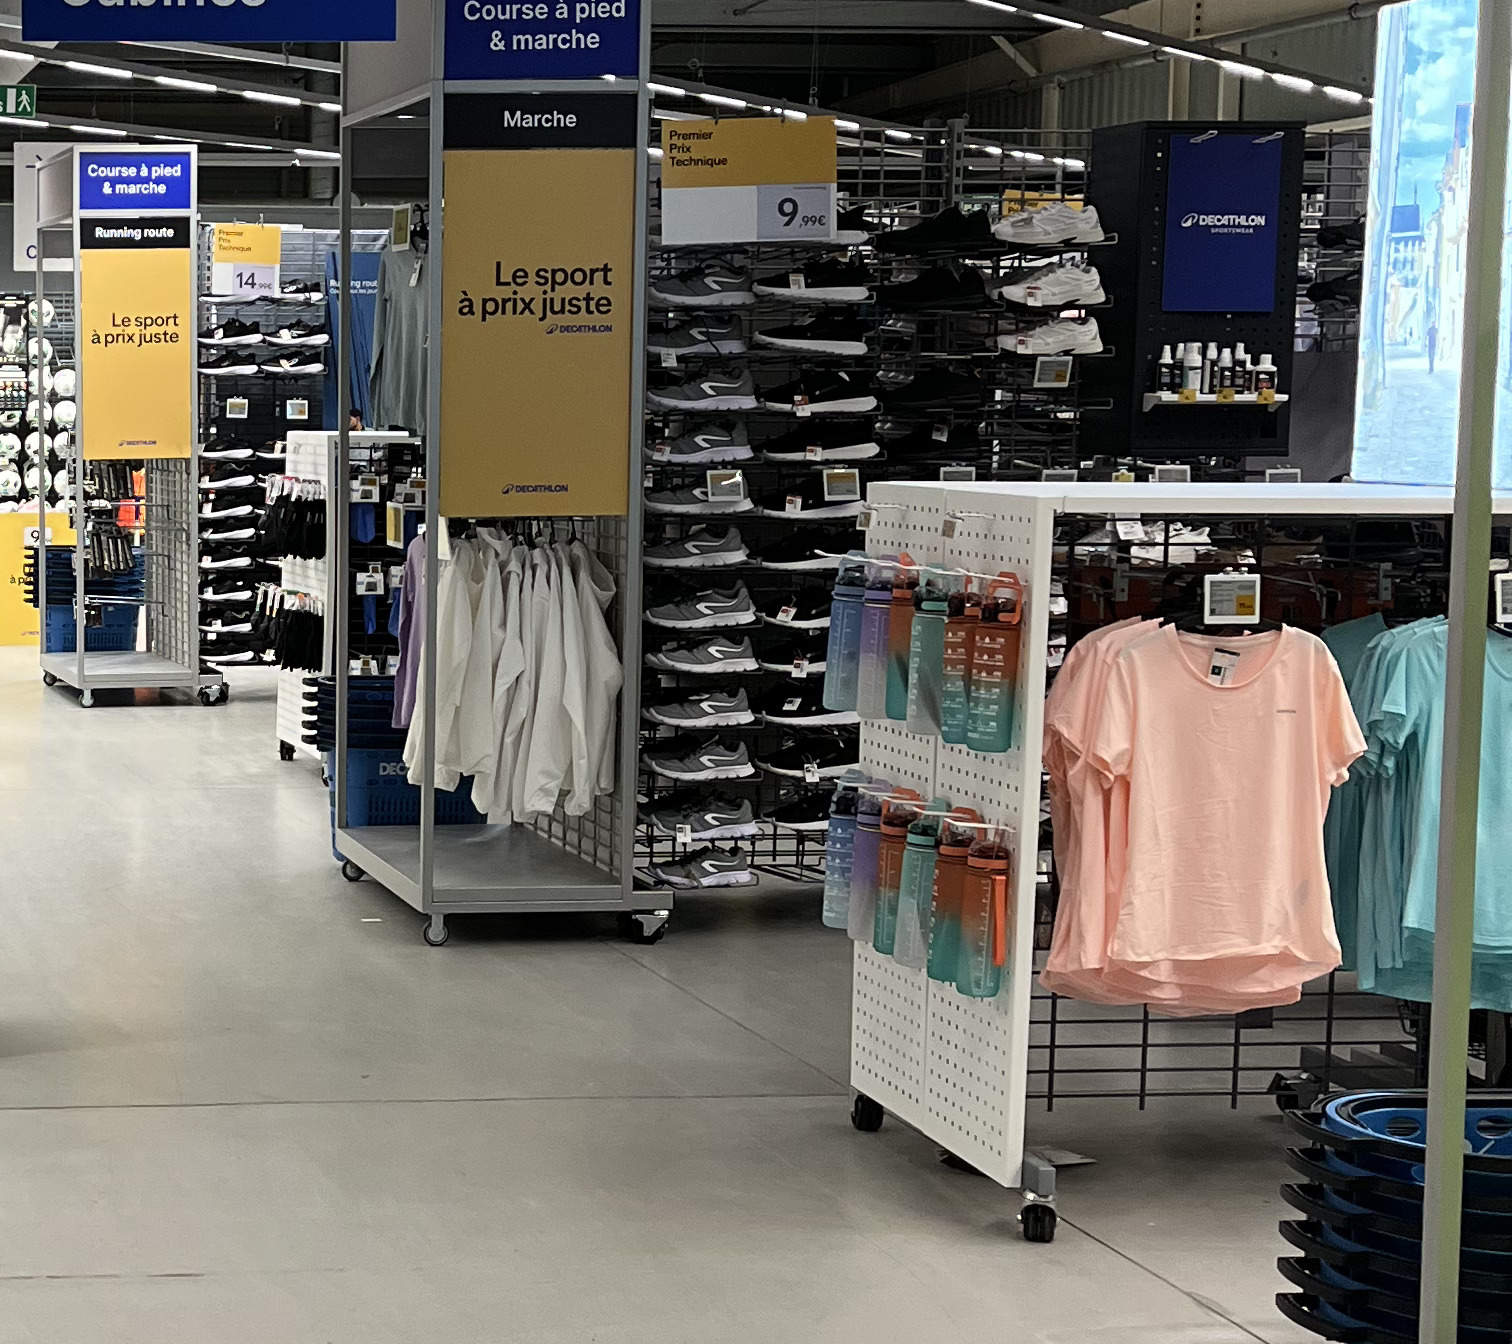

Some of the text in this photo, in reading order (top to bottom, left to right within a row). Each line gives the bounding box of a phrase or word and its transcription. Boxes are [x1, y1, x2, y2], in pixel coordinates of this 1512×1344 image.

[463, 0, 549, 21] Course
[490, 28, 600, 51] & marche
[503, 110, 577, 128] Marche
[669, 129, 714, 141] Premier
[669, 143, 692, 154] Prix
[669, 156, 728, 168] Technique
[88, 163, 181, 179] Course à pied
[102, 181, 166, 194] & marche
[1199, 215, 1266, 226] DECATHLON
[95, 226, 175, 240] Running route
[495, 260, 613, 293] Le sport
[457, 289, 613, 322] à prix juste
[112, 312, 179, 330] Le sport
[559, 324, 613, 333] DECATHLON
[91, 329, 179, 348] à prix juste
[515, 484, 568, 493] DECATHLON
